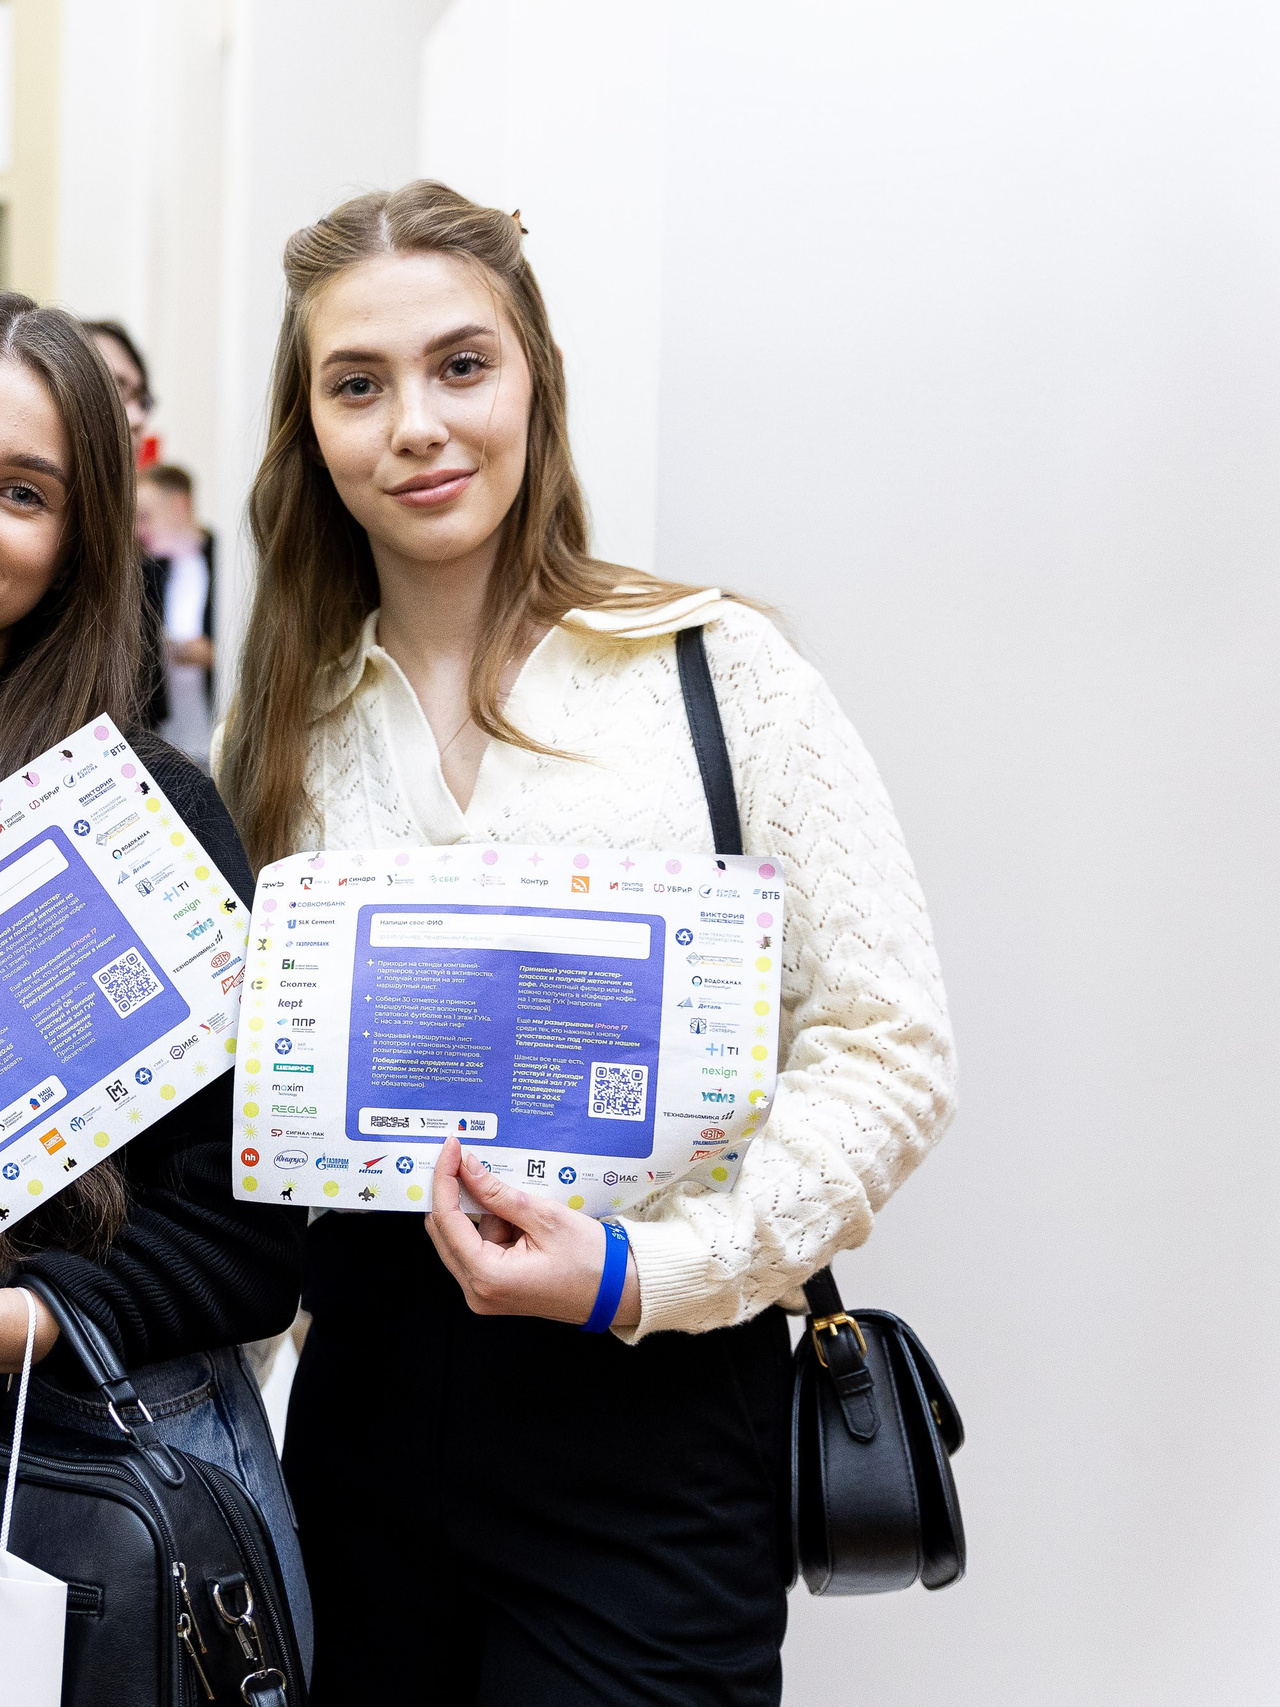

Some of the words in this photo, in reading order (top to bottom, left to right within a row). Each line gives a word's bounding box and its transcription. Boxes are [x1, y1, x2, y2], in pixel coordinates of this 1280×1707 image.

[109, 741, 126, 756] ВТБ
[39, 785, 60, 803] УБРиР
[79, 777, 113, 803] ВИКТОРИЯ
[121, 830, 150, 851] ВОДОКАНАЛ
[520, 877, 549, 886] Контур
[761, 891, 780, 900] ВТБ
[171, 897, 201, 921] nexign
[700, 911, 745, 919] ВИКТОРИЯ
[172, 942, 215, 974] ТЕХНОДИНАМИКА
[377, 960, 406, 968] Приходи
[415, 968, 444, 976] участвуй
[519, 964, 556, 974] Принимай
[558, 967, 587, 976] участие
[384, 974, 411, 982] получай
[704, 978, 742, 986] ВОДОКАНАЛ
[280, 980, 317, 988] Сколтех
[376, 981, 419, 990] маршрутный
[277, 998, 303, 1010] kept
[375, 1002, 418, 1011] маршрутный
[446, 998, 475, 1006] приноси
[375, 1010, 408, 1018] салатовой
[410, 1011, 441, 1020] футболке
[291, 1018, 316, 1027] ППР
[420, 1020, 447, 1028] вкусный
[544, 1018, 593, 1030] разыгрываем
[594, 1022, 618, 1031] iPhone
[181, 1033, 199, 1049] ИАС
[372, 1055, 418, 1065] Победителей
[419, 1058, 458, 1067] определим
[701, 1066, 738, 1079] nexign
[37, 1086, 52, 1098] НАШ
[272, 1083, 304, 1092] maxim
[41, 1090, 55, 1103] ДОМ
[271, 1104, 318, 1115] REGLAB
[663, 1111, 720, 1120] ТЕХНОДИНАМИКА
[244, 1153, 256, 1162] hh
